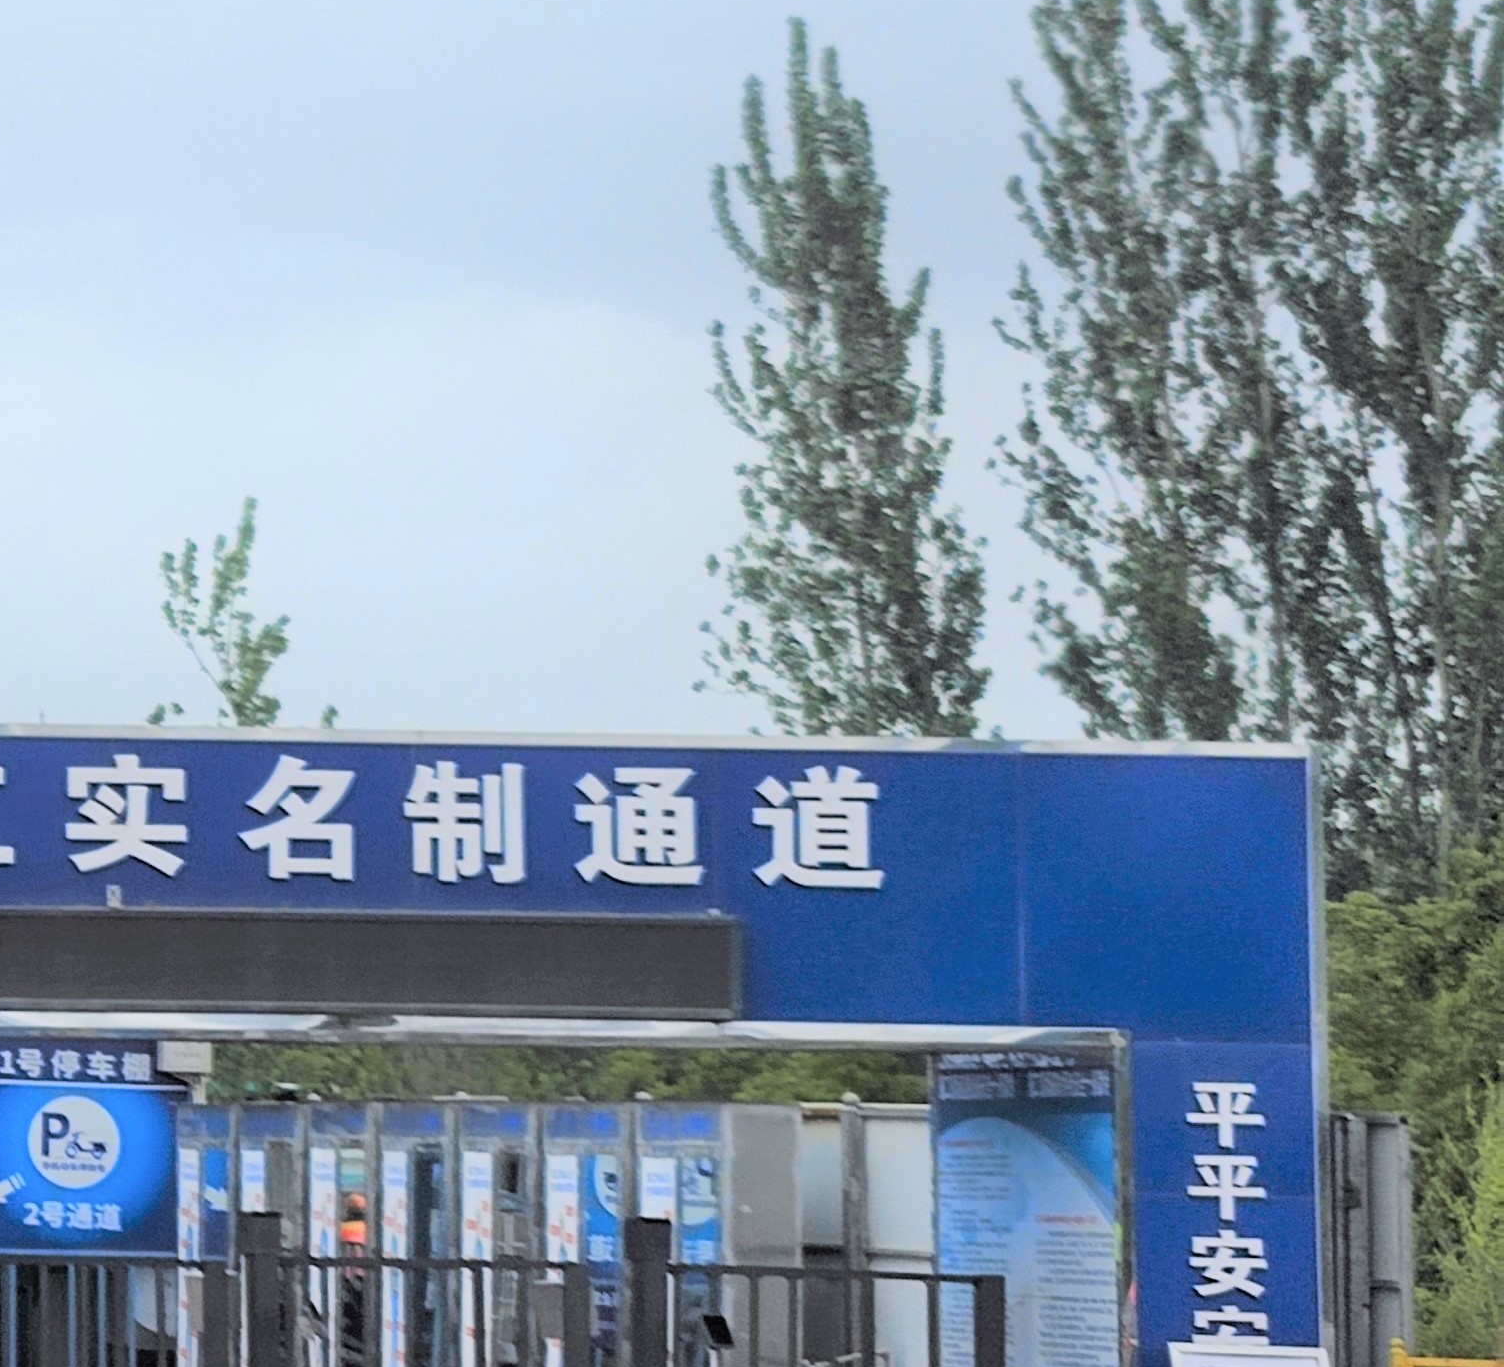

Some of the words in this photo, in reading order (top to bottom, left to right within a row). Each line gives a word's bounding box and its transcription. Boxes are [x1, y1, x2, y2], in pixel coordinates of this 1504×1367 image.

[42, 1112, 70, 1157] P
[22, 1201, 123, 1232] 2号通道
